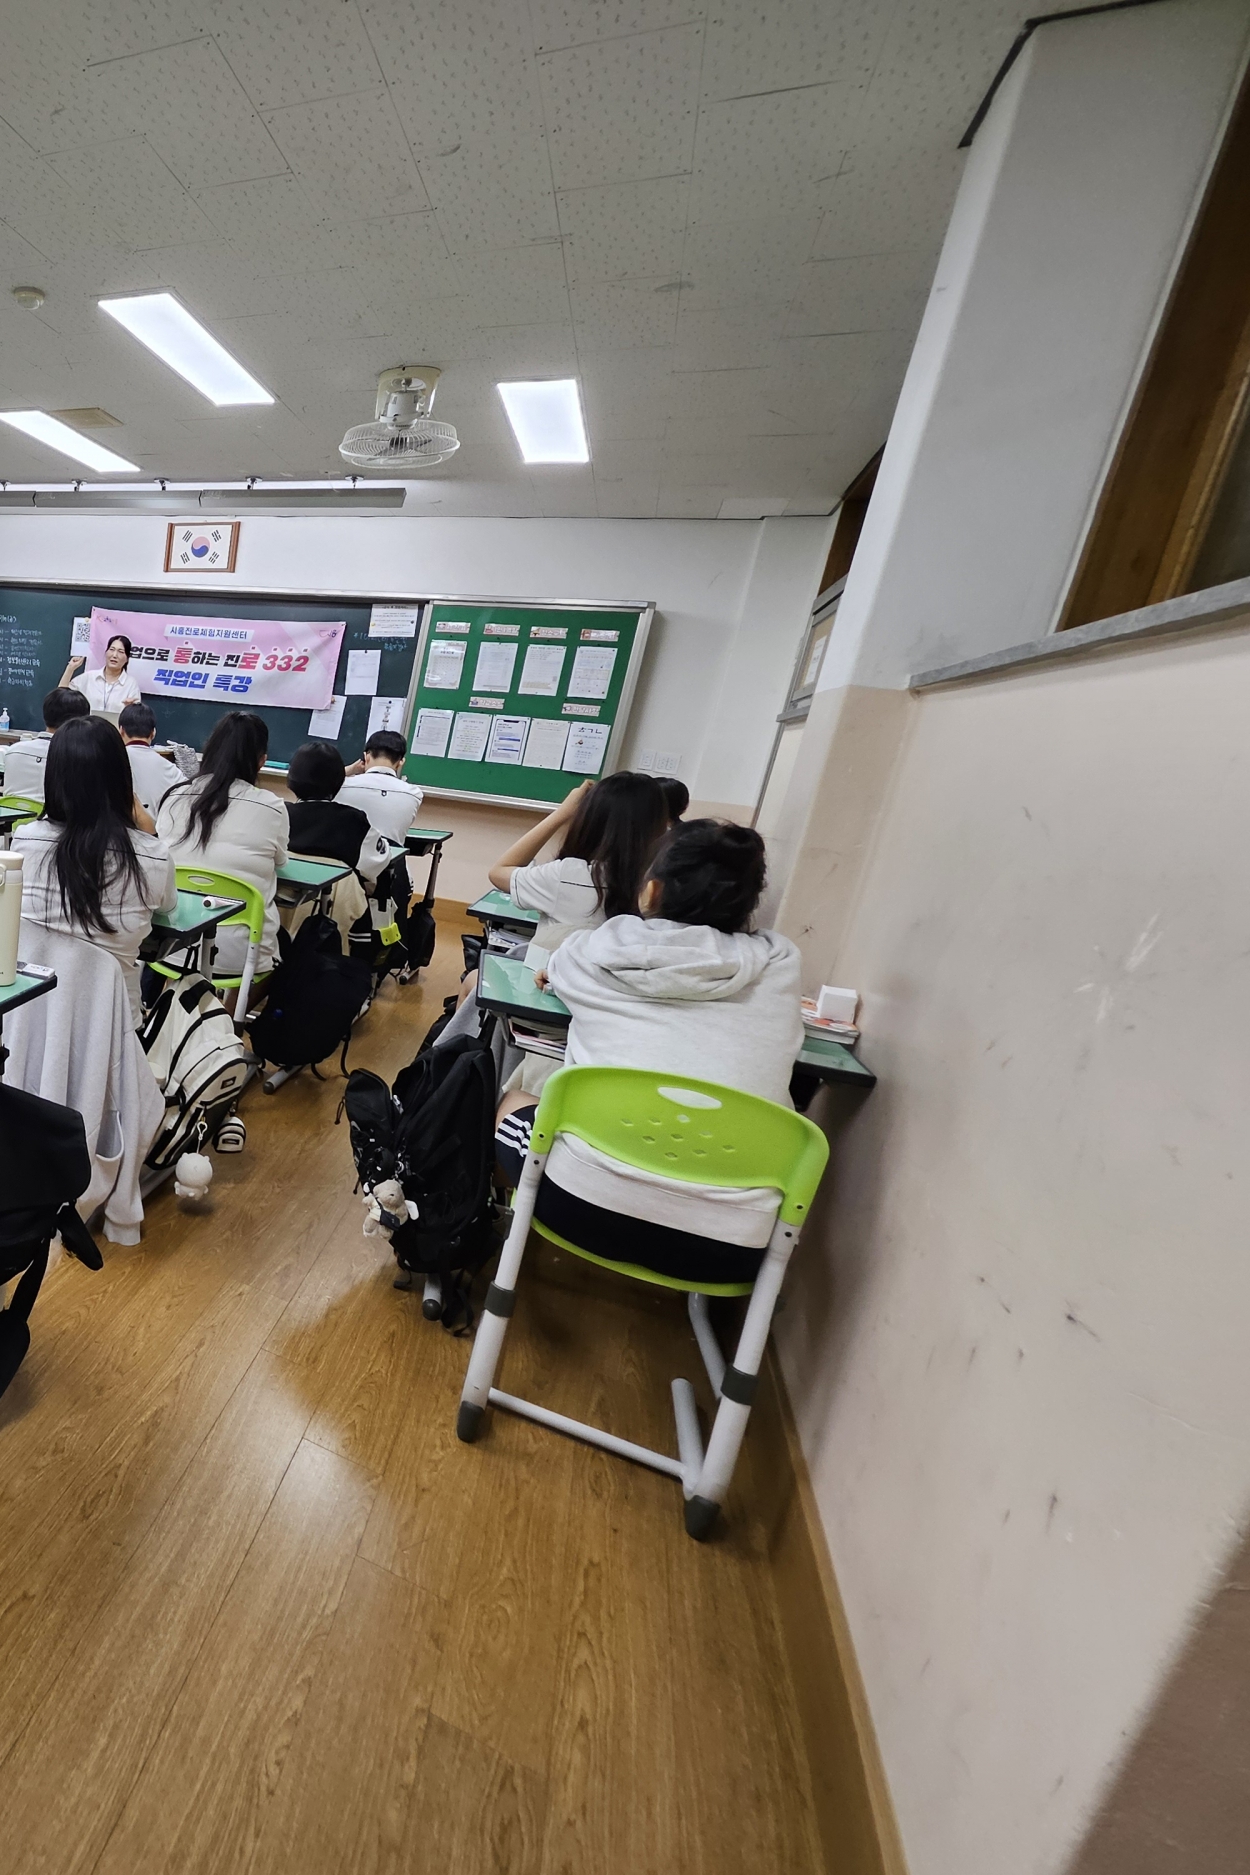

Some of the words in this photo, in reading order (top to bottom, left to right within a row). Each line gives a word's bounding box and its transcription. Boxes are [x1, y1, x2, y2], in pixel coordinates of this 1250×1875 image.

[170, 626, 247, 640] 시흥진로체험지원센터
[130, 646, 170, 662] 업으로
[173, 646, 220, 667] 통하는
[223, 652, 261, 670] 진로
[262, 654, 309, 672] 332
[153, 668, 210, 689] 직업인
[213, 674, 253, 693] 특강
